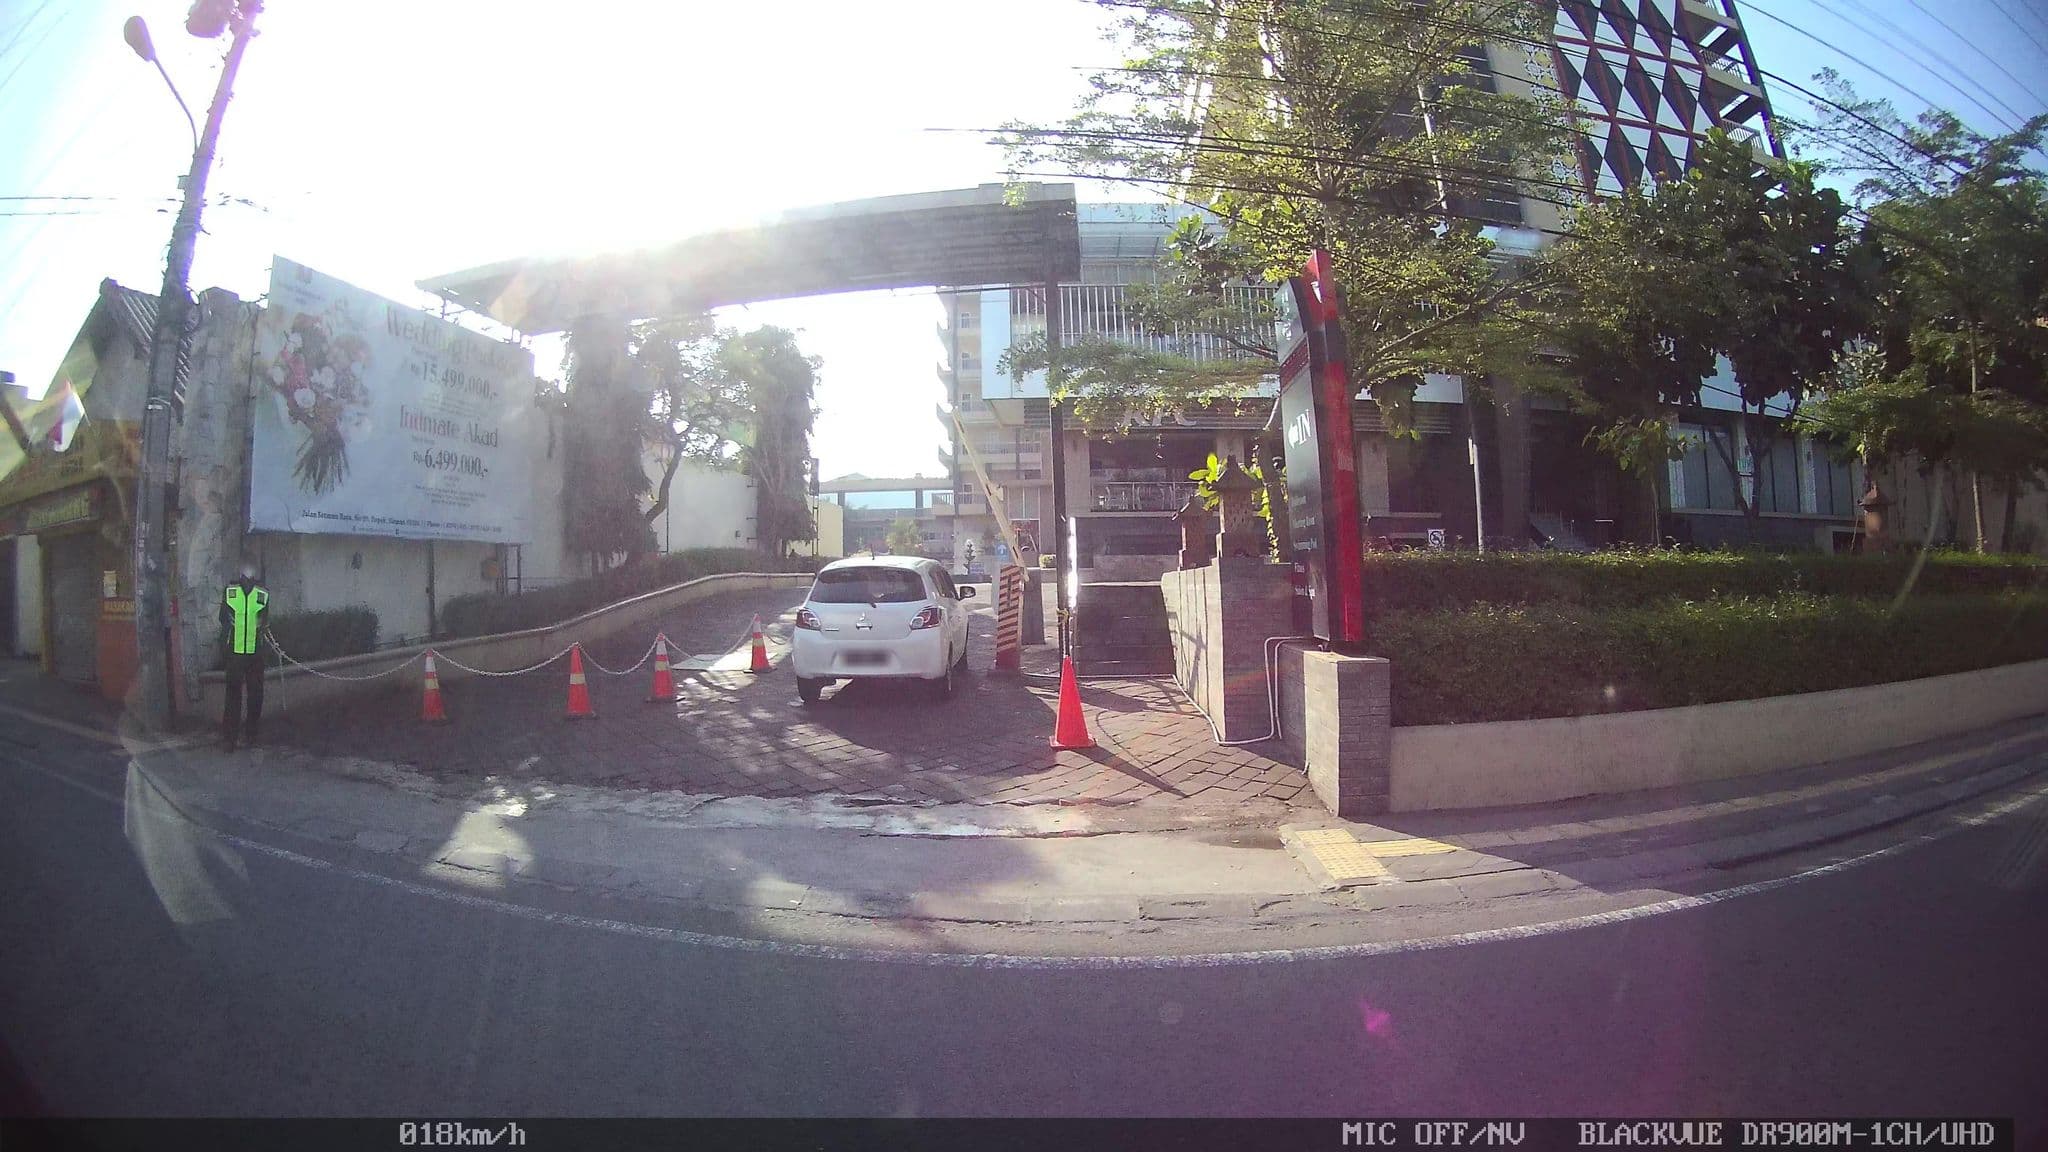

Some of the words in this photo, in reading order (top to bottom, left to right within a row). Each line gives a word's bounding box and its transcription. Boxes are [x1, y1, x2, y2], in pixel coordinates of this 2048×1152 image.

[400, 404, 460, 437] Intimate
[464, 419, 498, 447] Akad
[1296, 408, 1311, 445] IN
